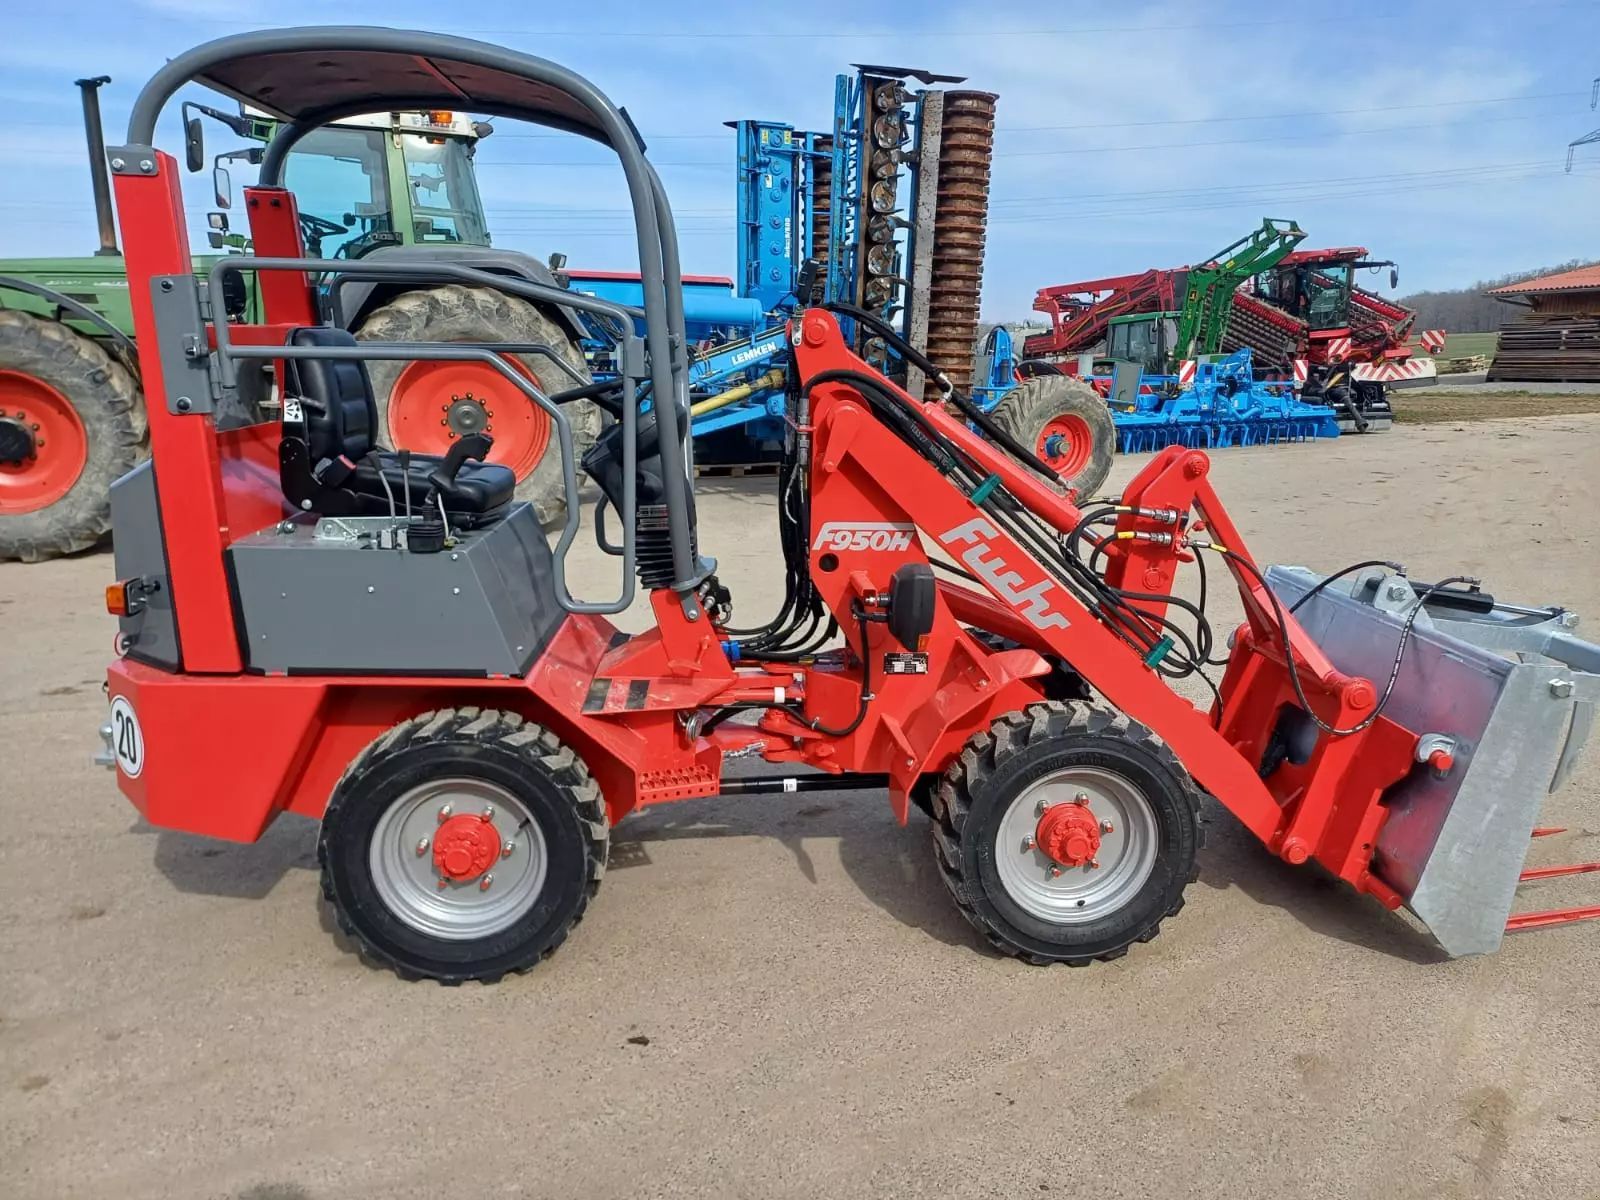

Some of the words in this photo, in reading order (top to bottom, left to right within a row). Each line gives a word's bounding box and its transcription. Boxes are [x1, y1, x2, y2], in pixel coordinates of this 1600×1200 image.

[731, 341, 777, 365] LEMKEN
[812, 522, 914, 551] F950H
[939, 517, 1071, 630] Fuchs
[116, 709, 136, 764] 20
